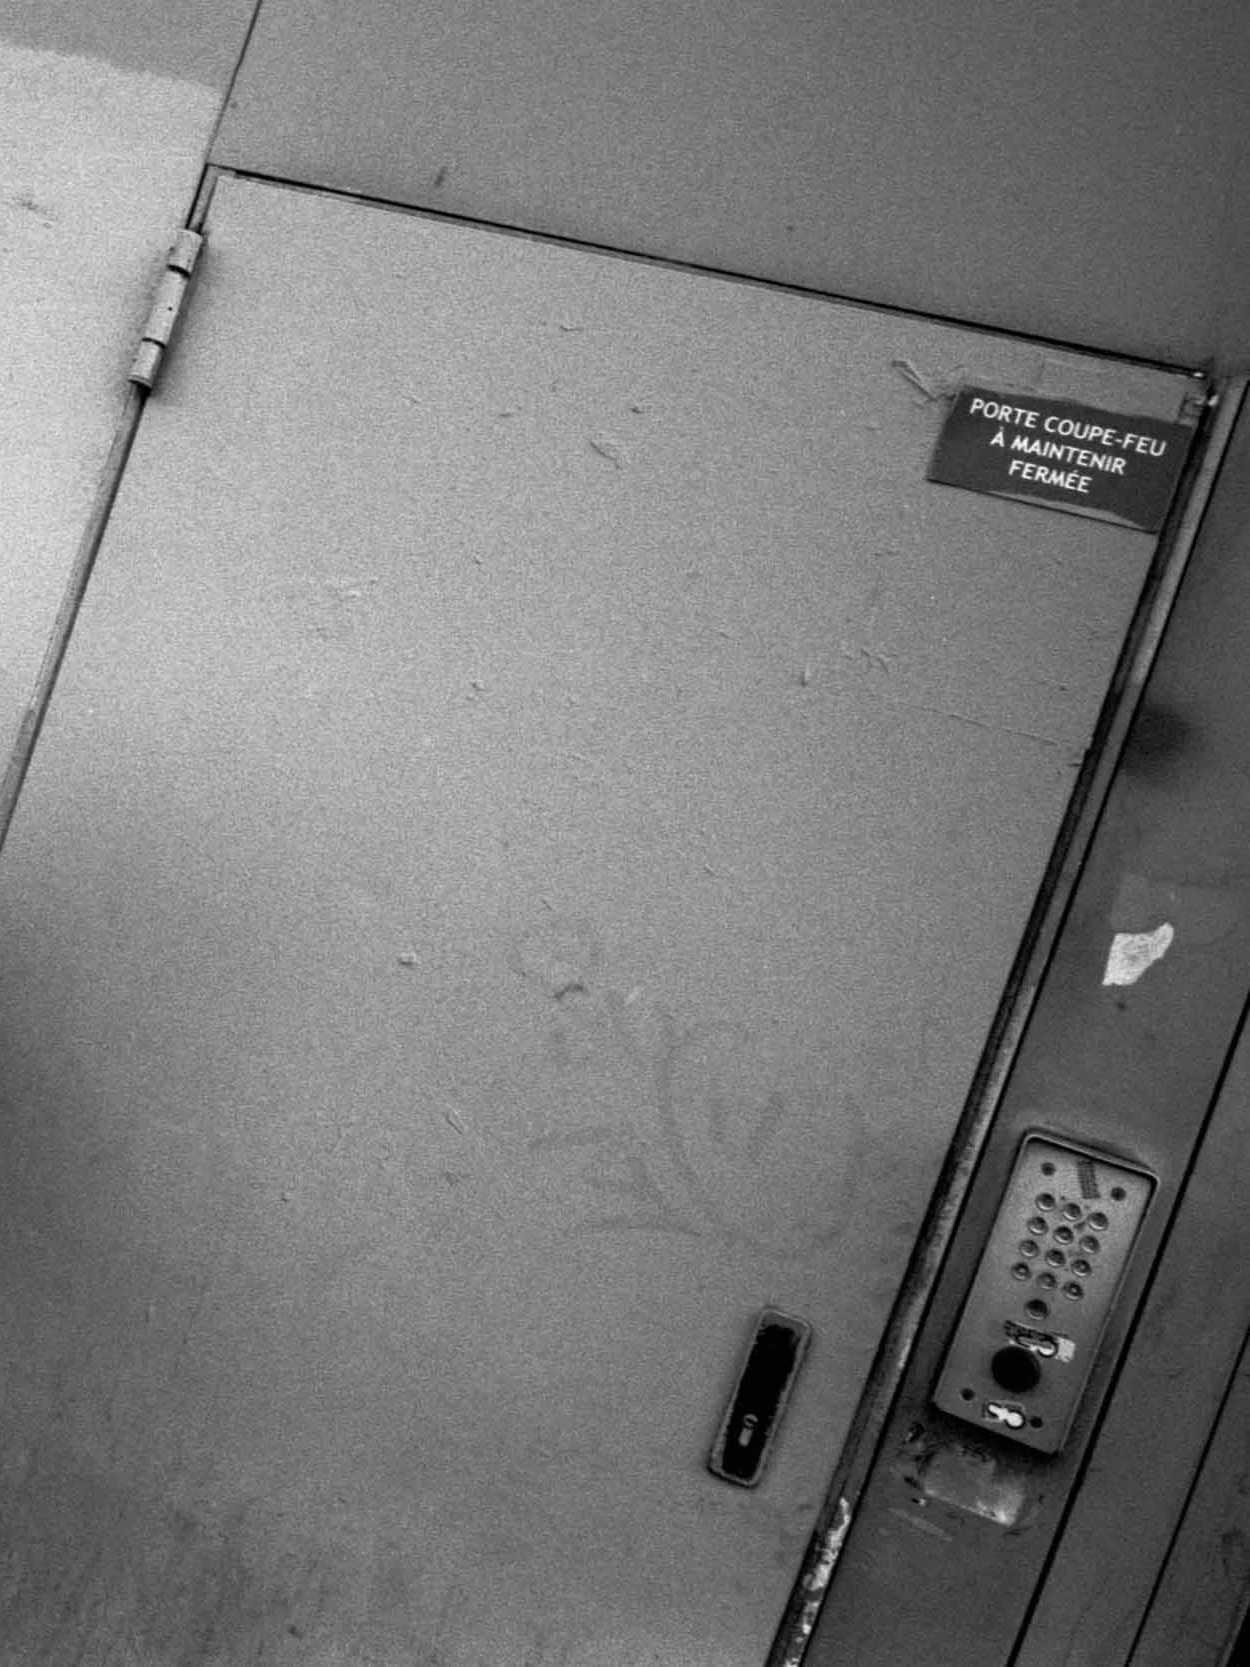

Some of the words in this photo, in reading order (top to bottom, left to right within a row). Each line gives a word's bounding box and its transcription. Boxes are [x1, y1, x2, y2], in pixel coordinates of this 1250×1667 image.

[969, 397, 1040, 429] PORTE
[1043, 415, 1167, 457] COUPE-FEU
[1010, 435, 1127, 475] MAINTENIR
[1008, 460, 1092, 494] FERMÉE
